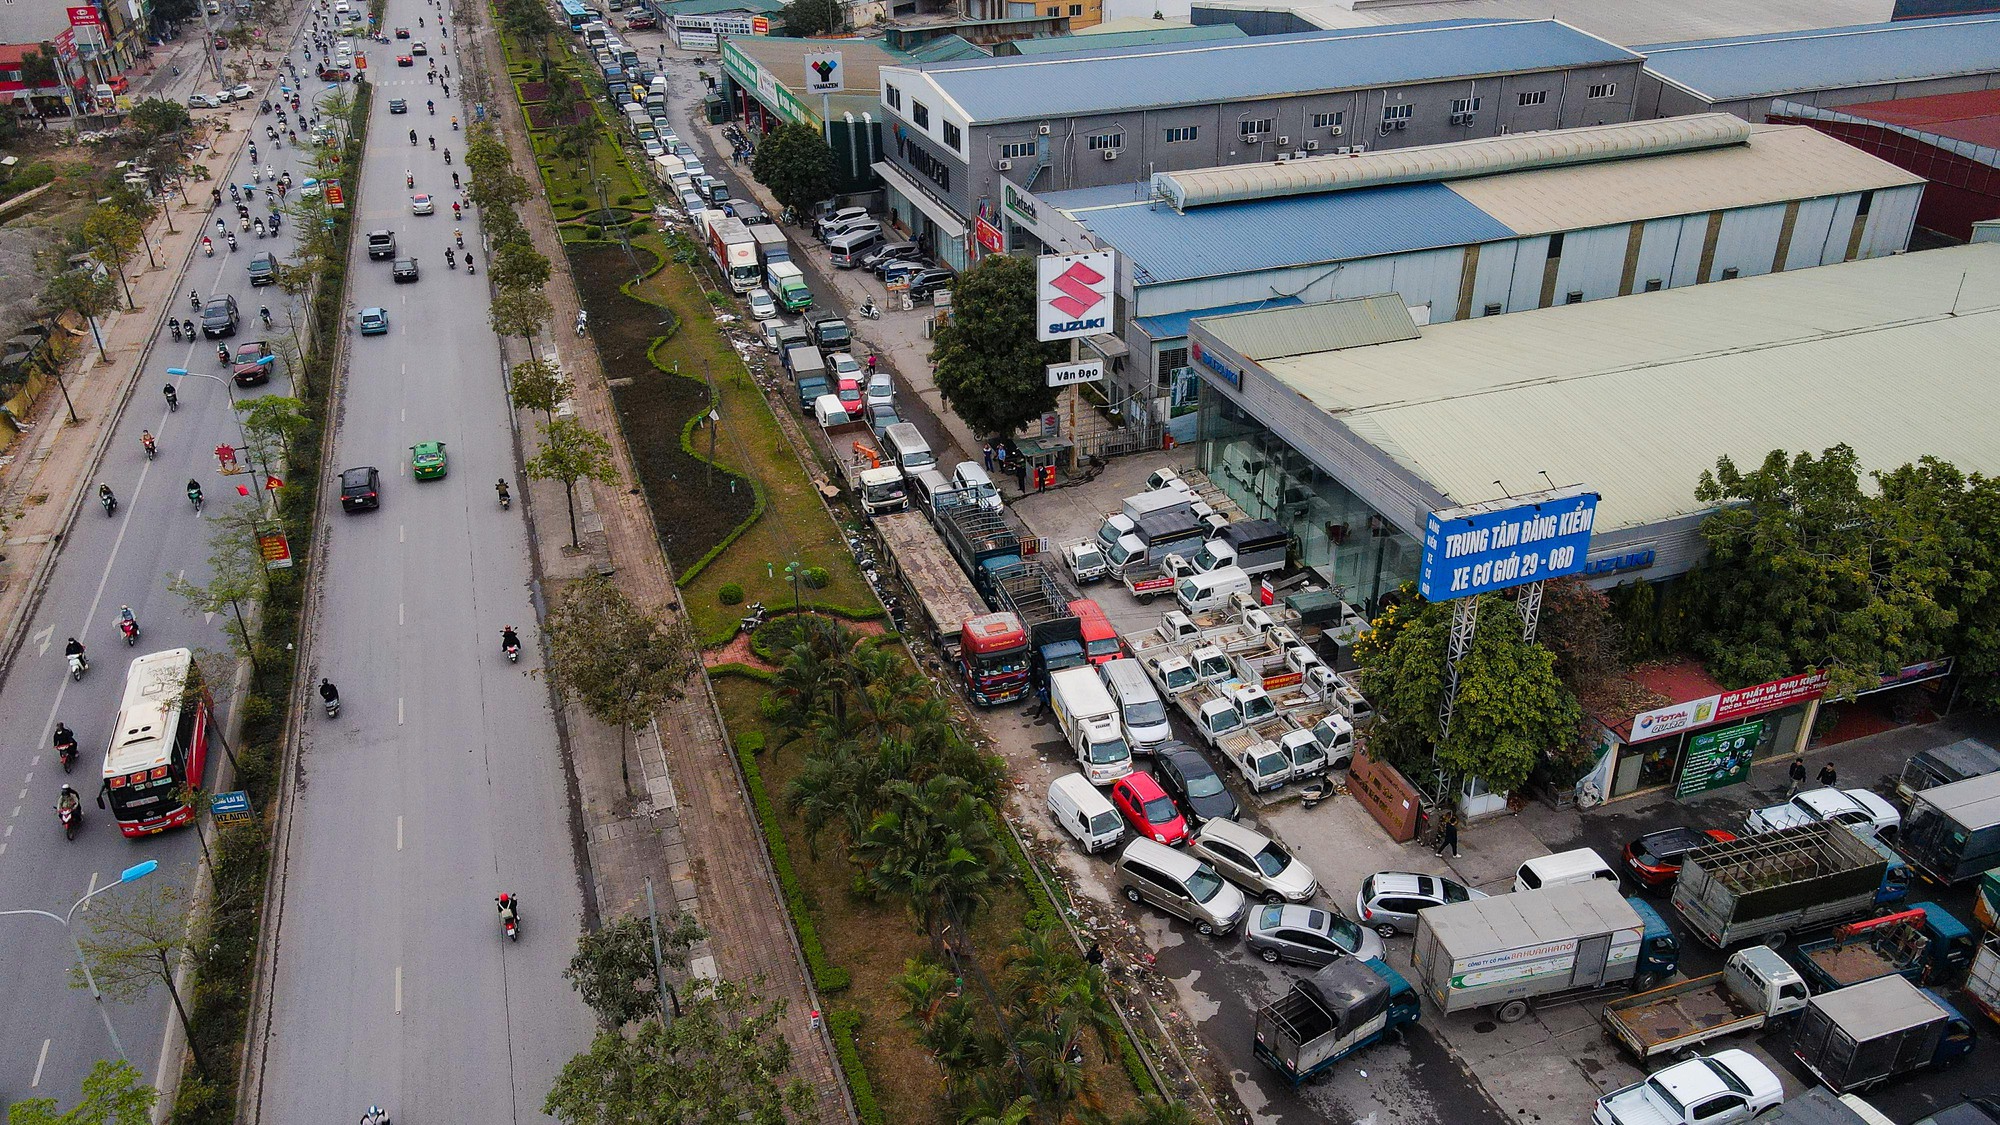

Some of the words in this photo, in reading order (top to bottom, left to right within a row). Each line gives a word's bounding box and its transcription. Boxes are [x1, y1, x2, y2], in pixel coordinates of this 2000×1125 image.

[1049, 317, 1105, 334] SUZUKI
[1056, 371, 1076, 381] Vân
[1078, 369, 1098, 379] Đạo
[1202, 351, 1238, 385] SUZUKI
[1445, 528, 1489, 559] TRUNG
[1491, 520, 1520, 550] TÂM
[1520, 513, 1558, 544] ĐĂNG
[1558, 501, 1593, 537] KIỂM
[1450, 566, 1471, 592] XE
[1472, 560, 1493, 587] CƠ
[1492, 551, 1520, 583] GIỚI
[1520, 552, 1539, 577] 29
[1548, 545, 1575, 572] 08D
[1581, 548, 1655, 576] UZUKI
[1655, 711, 1688, 723] TOTAL
[229, 812, 249, 821] AUTO
